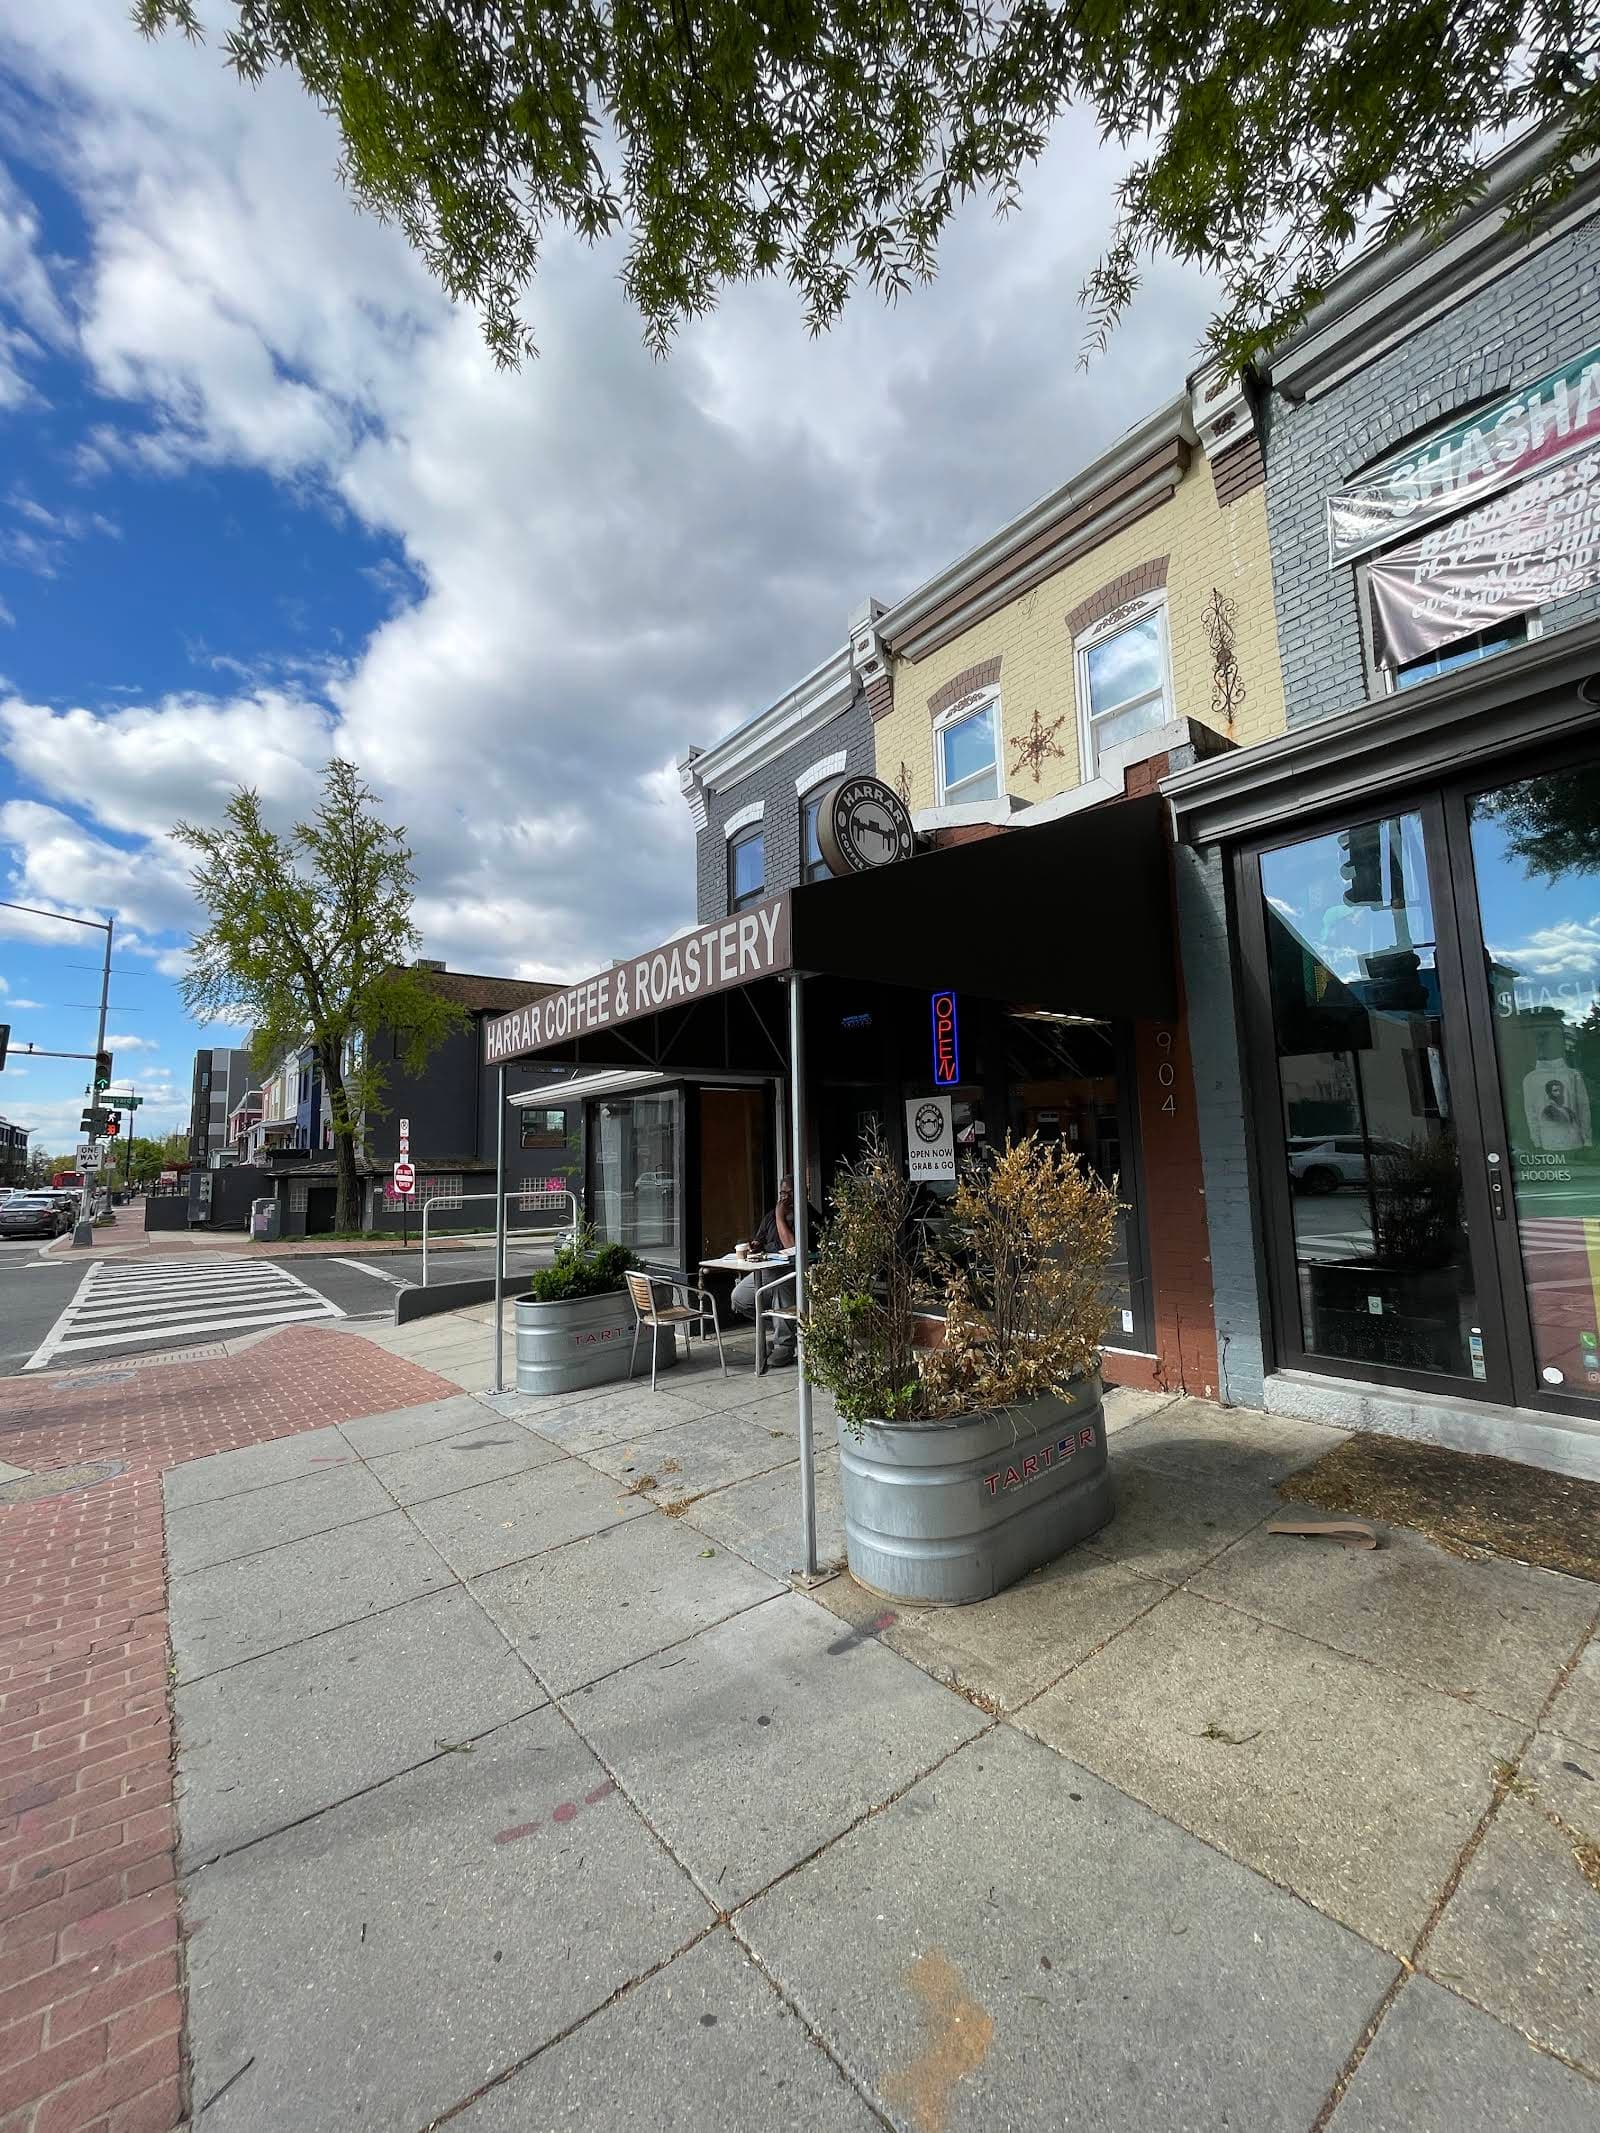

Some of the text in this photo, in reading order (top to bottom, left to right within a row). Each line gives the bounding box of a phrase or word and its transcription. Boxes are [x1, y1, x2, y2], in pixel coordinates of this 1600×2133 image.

[843, 785, 903, 824] HARRAR
[841, 833, 870, 870] COFFE
[487, 902, 782, 1060] HARRAR COFFEE & ROASTERY
[936, 997, 956, 1081] OPEN
[1156, 1031, 1177, 1118] 904
[910, 1149, 953, 1159] OPEN NOW
[912, 1162, 932, 1171] GRAB
[941, 1161, 954, 1169] GO
[1520, 1154, 1567, 1165] CUSTOM
[1521, 1170, 1572, 1181] HOODIES
[575, 1323, 652, 1346] TART
